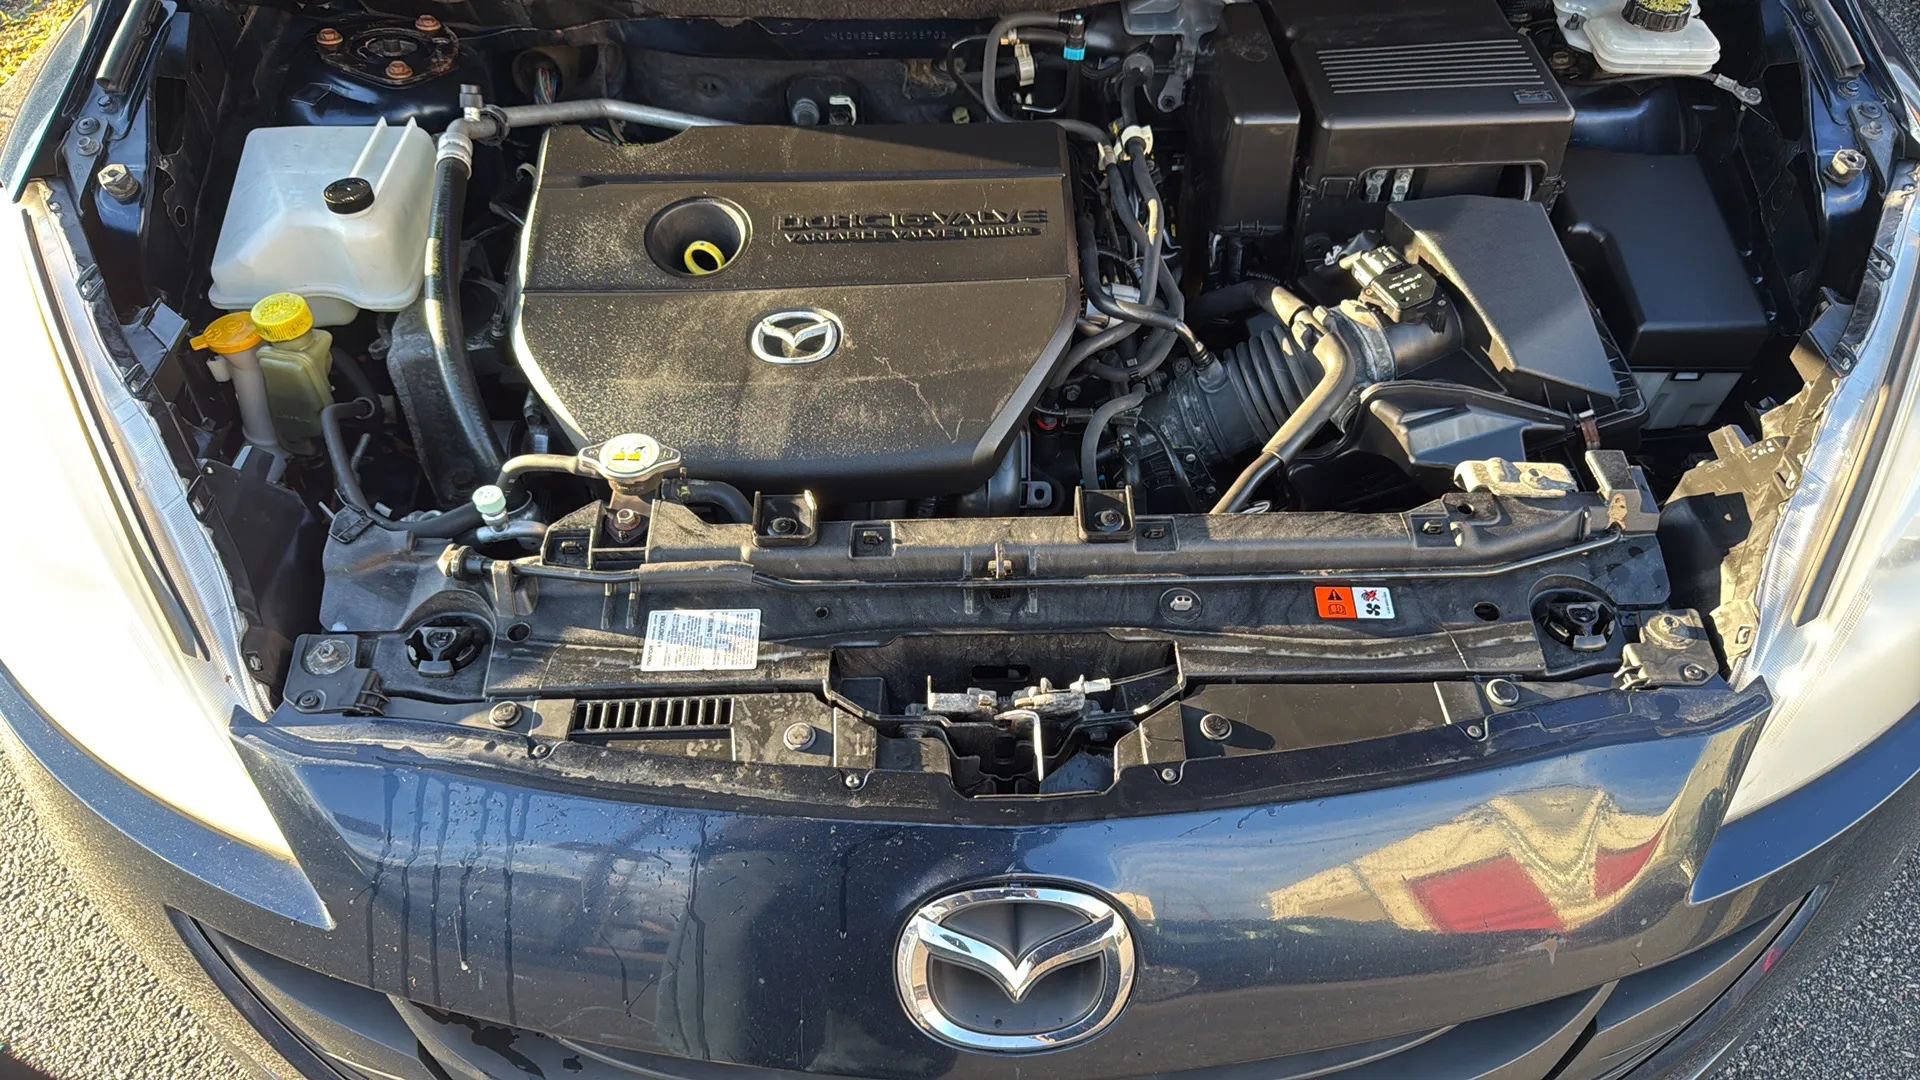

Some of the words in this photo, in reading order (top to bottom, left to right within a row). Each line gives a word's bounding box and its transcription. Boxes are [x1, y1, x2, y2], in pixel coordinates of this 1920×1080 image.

[783, 230, 888, 243] VARIABLE
[891, 228, 957, 240] VALVE
[958, 225, 1037, 238] TIMING
